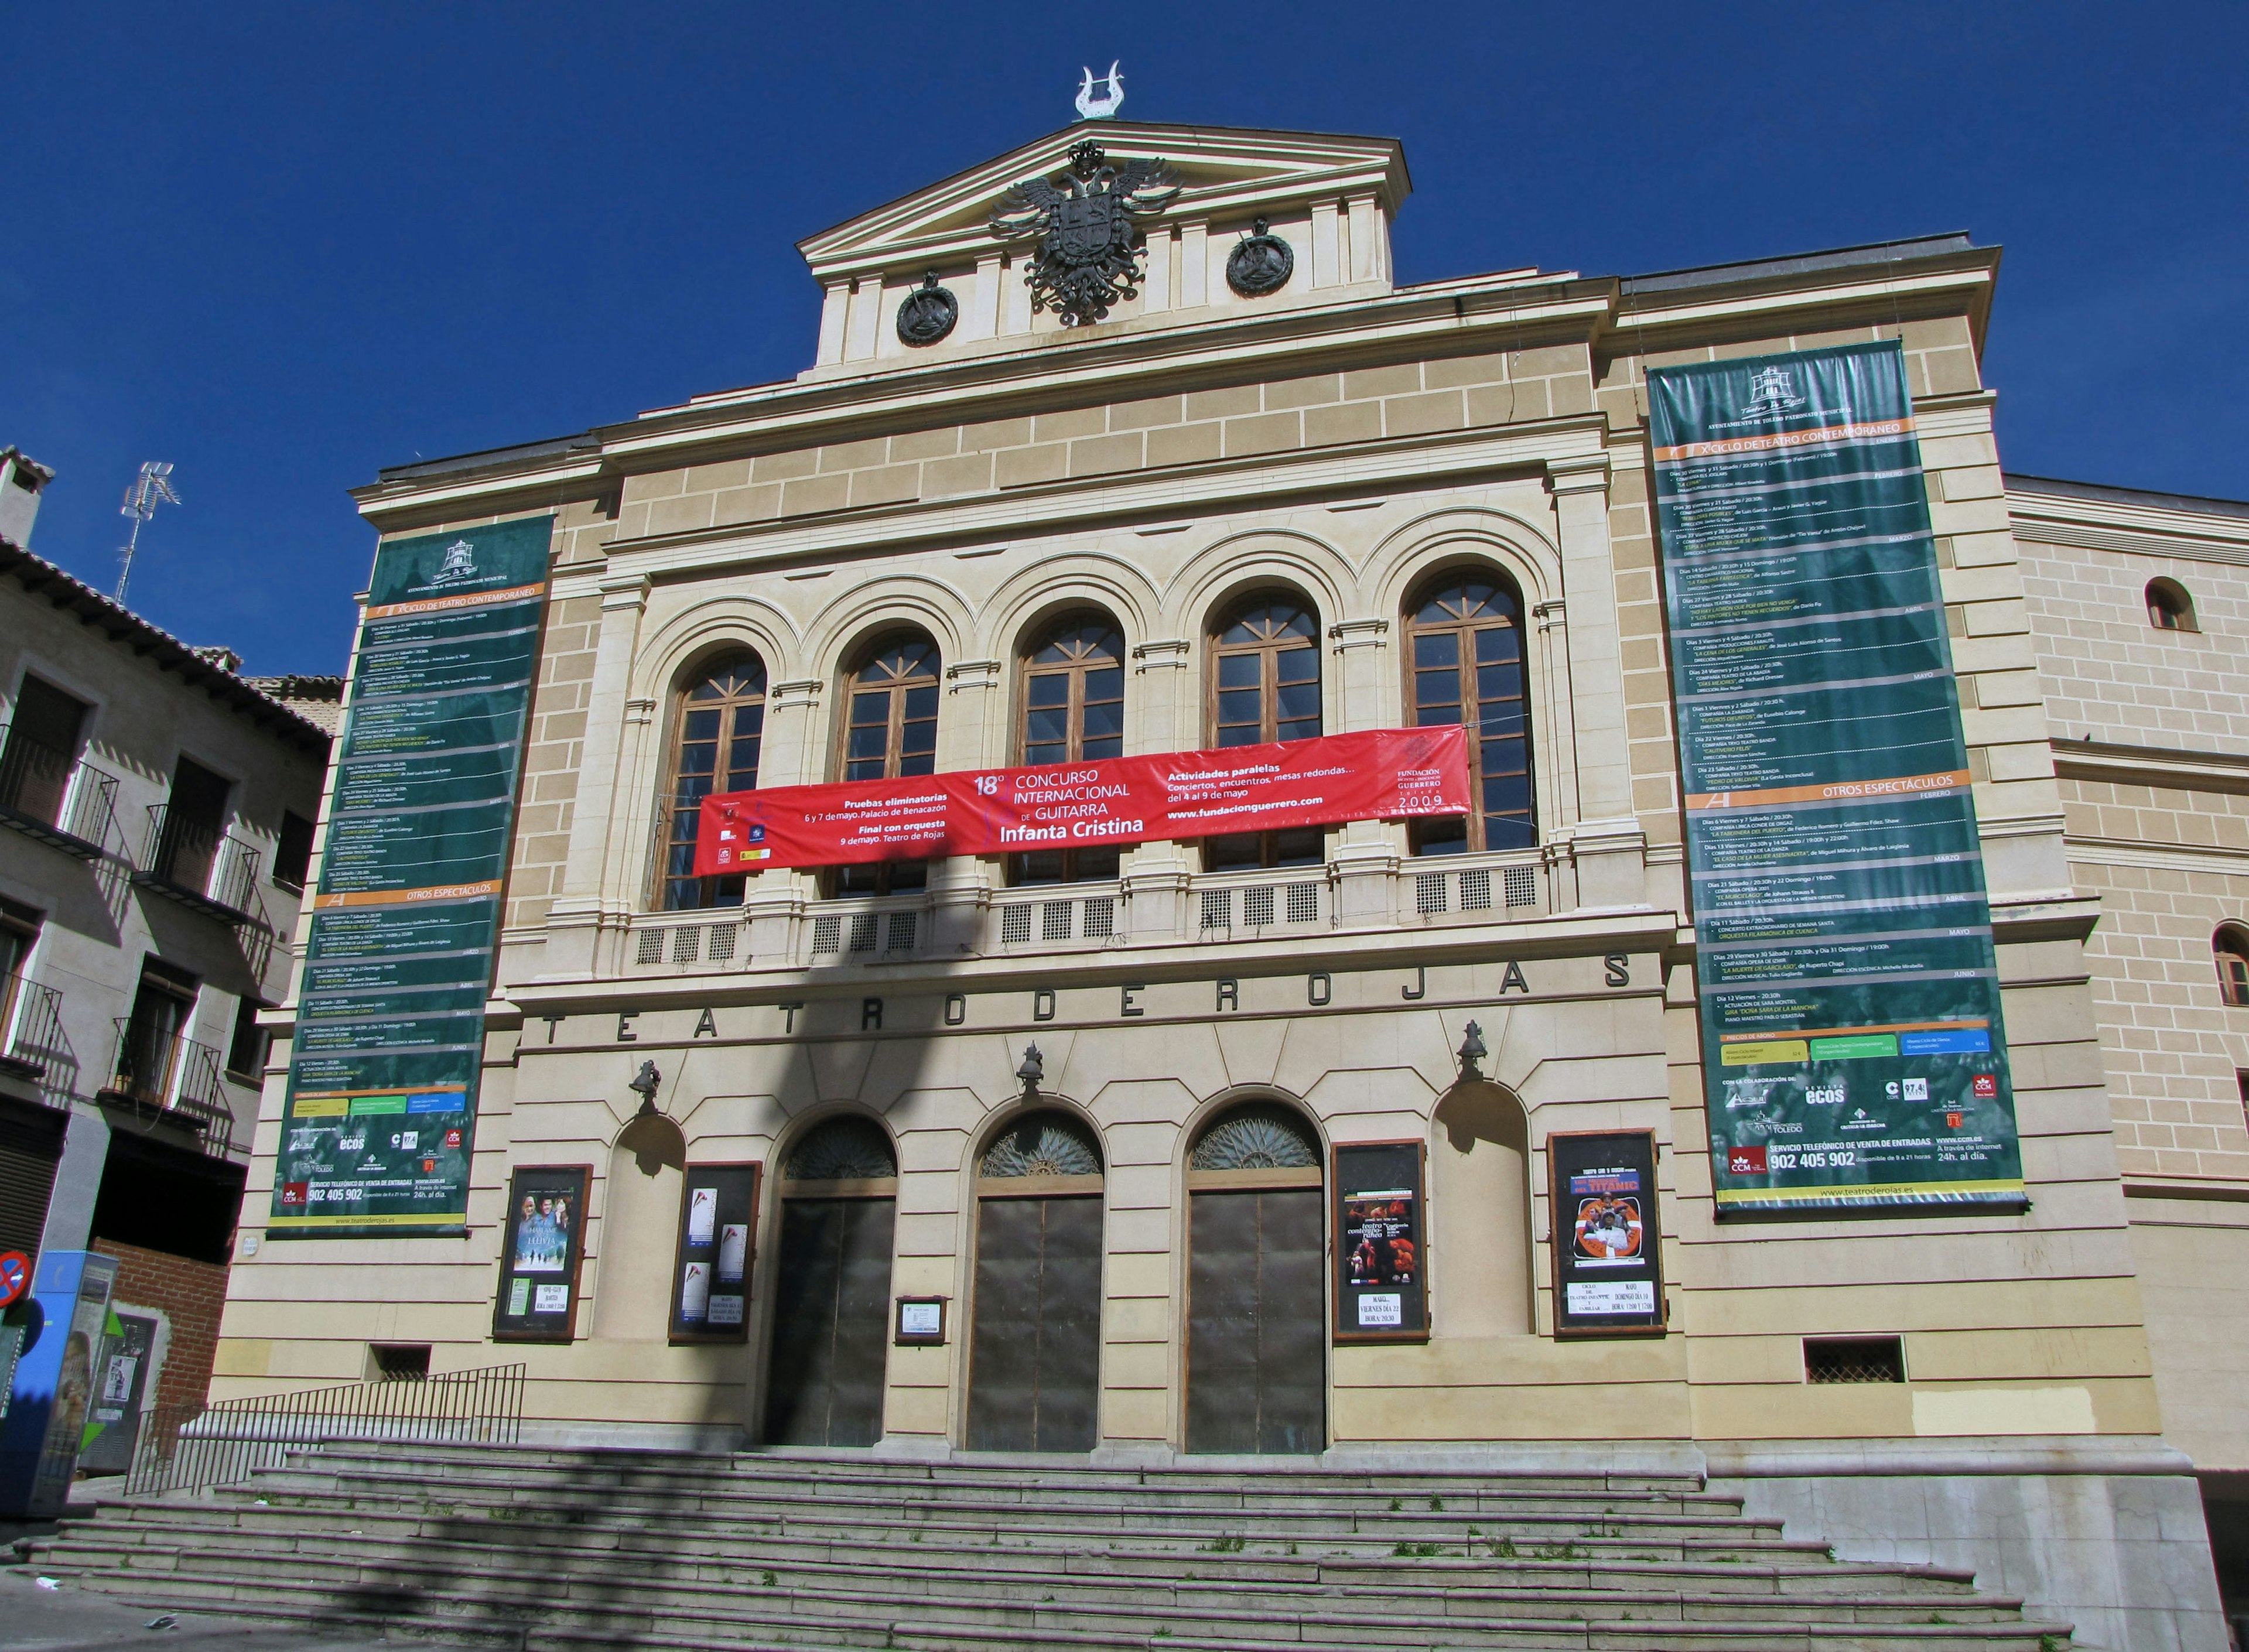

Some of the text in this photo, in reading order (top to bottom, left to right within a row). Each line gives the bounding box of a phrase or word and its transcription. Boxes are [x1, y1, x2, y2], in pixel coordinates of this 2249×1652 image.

[1708, 420, 1752, 430] AYUNTAMIENTO
[1762, 416, 1784, 424] TOLEDO
[1785, 412, 1818, 422] PATRONATO
[1819, 407, 1852, 416] MUNICIPAL
[1710, 442, 1741, 453] CICLO
[1744, 440, 1759, 450] DE
[1761, 435, 1799, 449] TEATRO
[1876, 436, 1898, 444] ENERO
[1874, 470, 1903, 478] FEBRERO
[1888, 534, 1913, 543] MARZO
[404, 604, 426, 612] CICLO
[439, 598, 466, 608] TEATRO
[467, 587, 535, 605] CONTEMPORÁNEO
[1905, 606, 1923, 614] ABRIL
[1913, 672, 1933, 680] MAYO
[1016, 769, 1098, 789] CONCURSO
[1168, 764, 1280, 781] Actividades paralelas
[1397, 768, 1440, 777] FUNDACIÓN
[1167, 782, 1217, 792] Conciertos,
[1219, 777, 1271, 788] encuentros,
[1274, 773, 1301, 782] mesas
[1398, 781, 1441, 789] GUERRERO
[1823, 774, 1953, 797] OTROS ESPECTÁCULOS
[844, 793, 947, 809] Pruebas eliminatorias
[1014, 784, 1130, 804] INTERNACIONAL
[1167, 793, 1181, 803] del
[1210, 791, 1222, 799] de
[1223, 789, 1248, 799] mayo
[1920, 790, 1950, 799] FEBRERO
[1167, 796, 1323, 819] www.fundacionguerrero.com
[1399, 795, 1442, 808] 2009
[805, 814, 810, 822] 6
[811, 816, 816, 824] y
[860, 808, 889, 818] Palacio
[891, 808, 901, 816] de
[903, 804, 946, 815] Benacazón
[1035, 803, 1109, 820] GUITARRA
[859, 825, 881, 834] Final
[904, 820, 945, 831] orquesta
[1000, 818, 1143, 842] Infanta Cristina
[840, 837, 846, 846] 9
[883, 833, 908, 842] Teatro
[923, 830, 945, 840] Rojas
[1933, 854, 1960, 862] MARZO
[407, 883, 491, 900] OTROS ESPECTÁCULOS
[1945, 895, 1966, 903] ABRIL
[1949, 928, 1970, 936] MAYO
[542, 953, 1630, 1044] TEATRO DE ROJAS
[1806, 1089, 1844, 1104] ecos
[340, 1138, 365, 1150] ecos
[1769, 1144, 1801, 1152] SERVICIO
[1803, 1141, 1845, 1151] TELEFÓNICO
[1857, 1140, 1881, 1148] VENTA
[1892, 1138, 1931, 1147] ENTRADAS
[1771, 1152, 1855, 1169] 902 405 902
[1937, 1151, 1988, 1162] 24h. al día.
[1590, 1181, 1638, 1192] TITANIC
[1820, 1186, 1913, 1196] www.teatroderojas.es
[309, 1188, 362, 1200] 902 405 902
